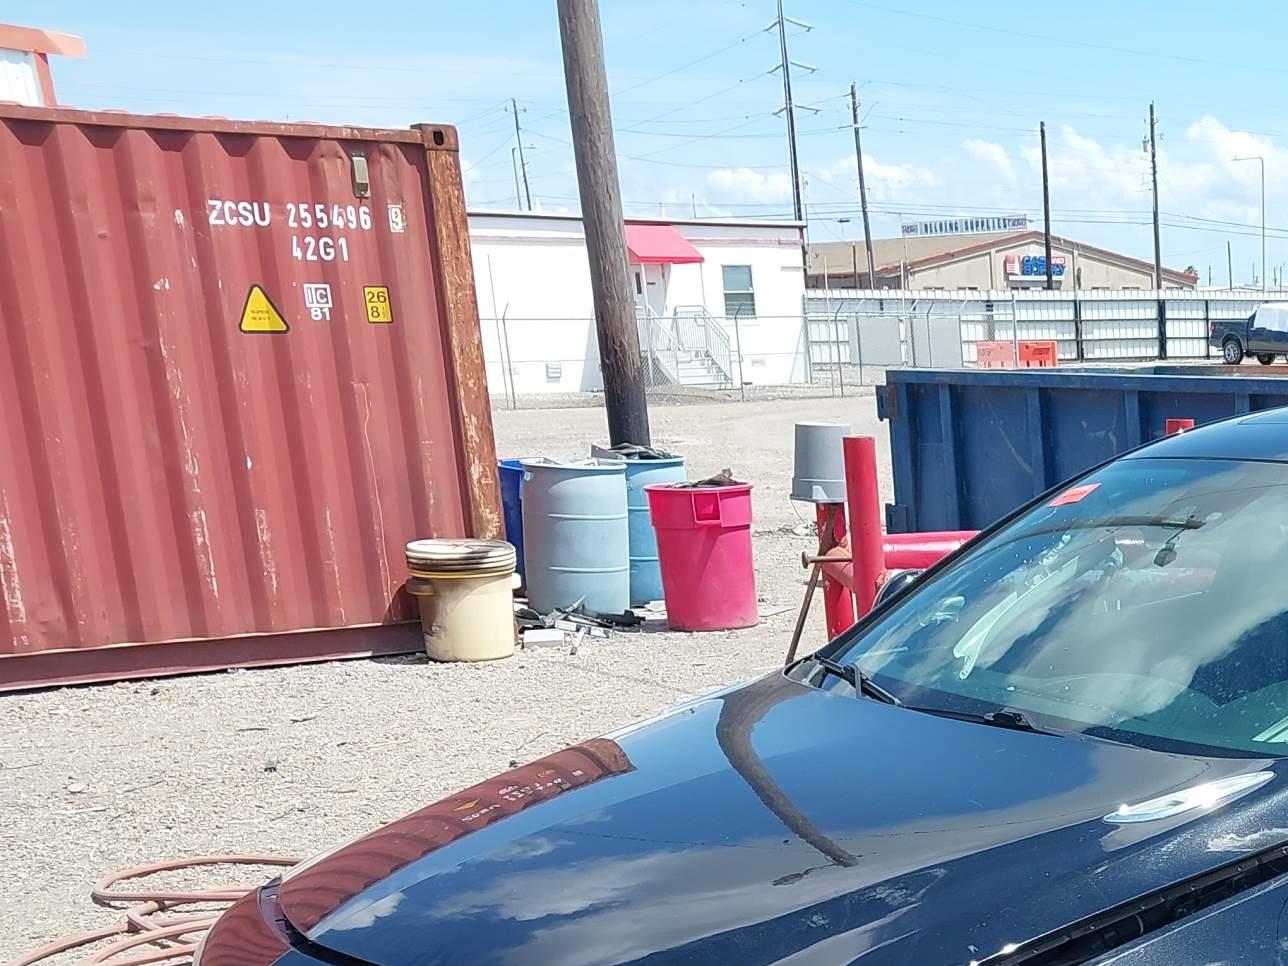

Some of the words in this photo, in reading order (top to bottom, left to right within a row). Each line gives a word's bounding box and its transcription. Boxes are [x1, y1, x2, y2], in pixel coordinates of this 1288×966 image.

[208, 200, 271, 226] ZCSU
[286, 203, 371, 230] 255496
[390, 206, 403, 231] 9
[292, 236, 348, 261] 42G1
[367, 291, 386, 303] 26
[311, 307, 330, 320] 81
